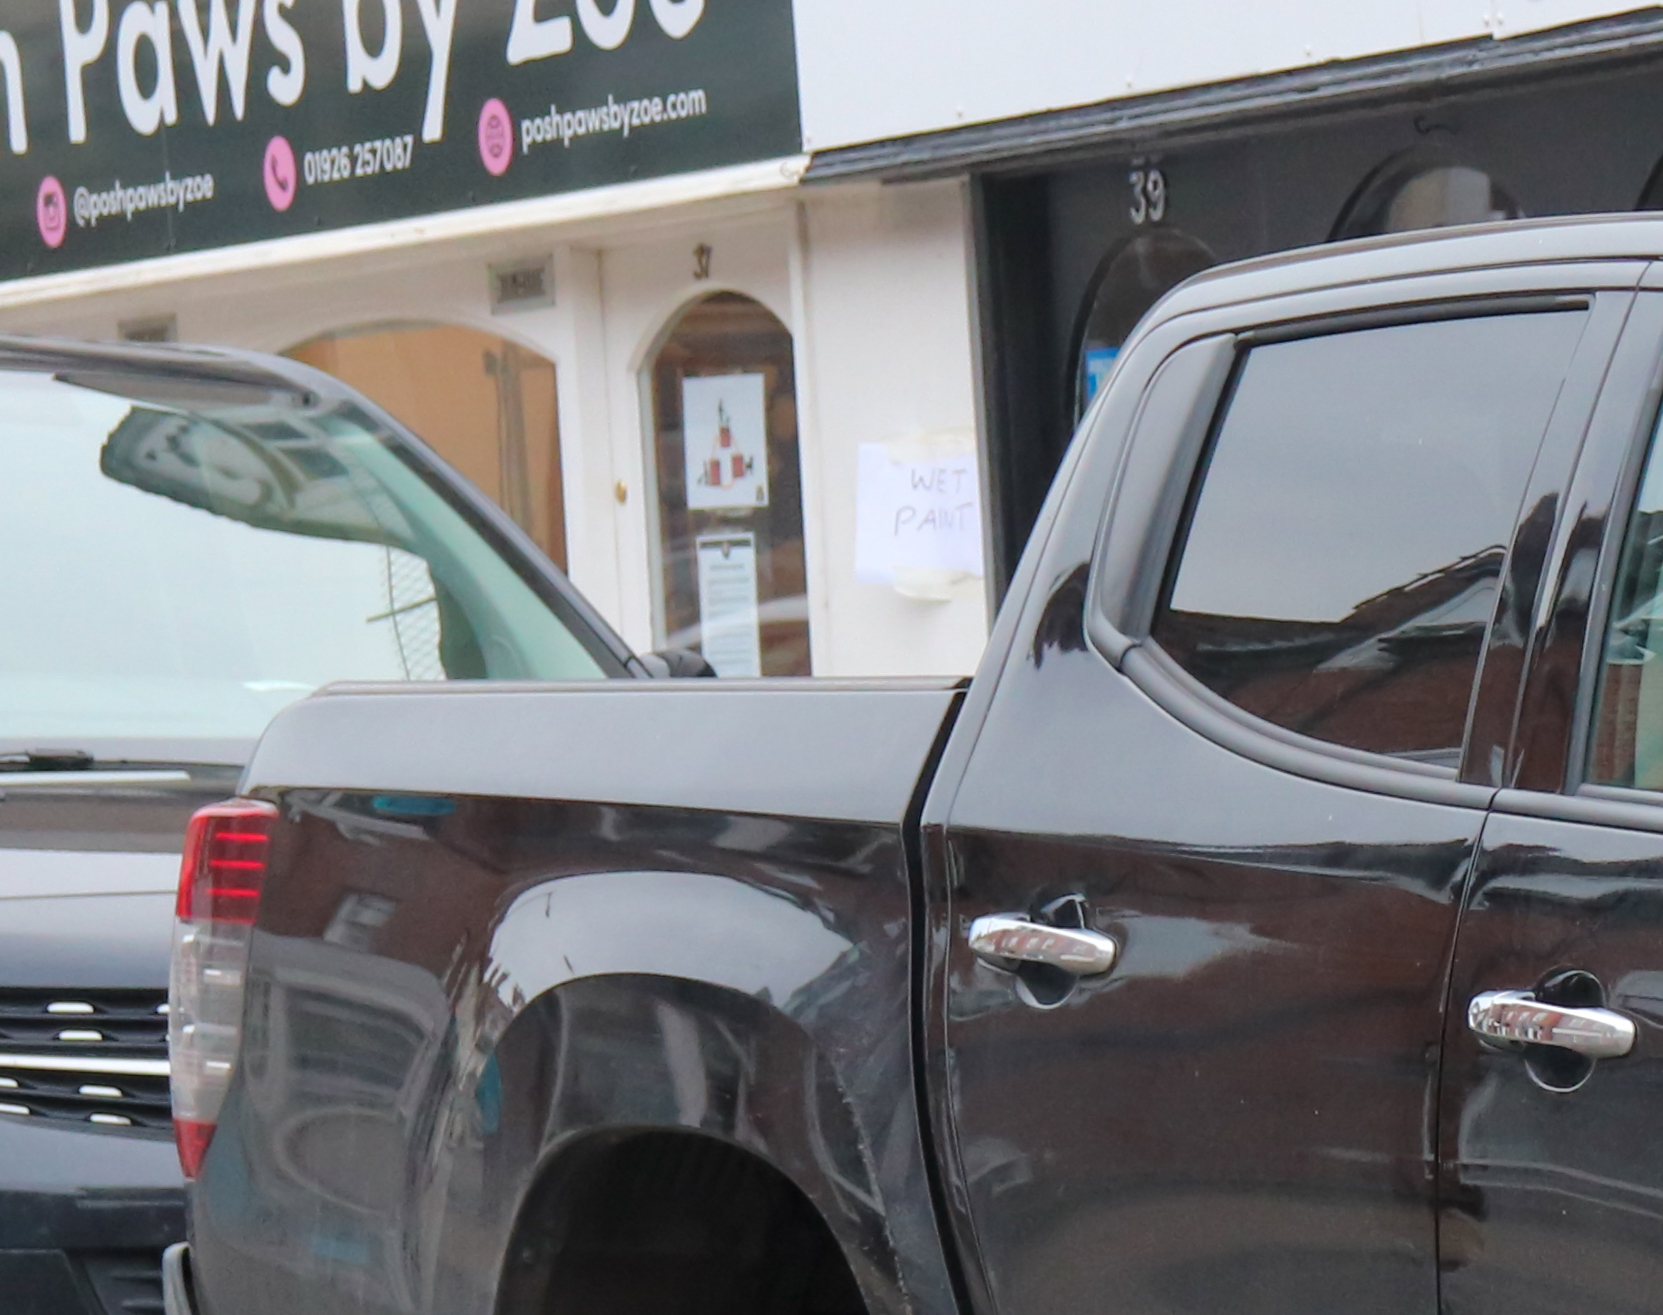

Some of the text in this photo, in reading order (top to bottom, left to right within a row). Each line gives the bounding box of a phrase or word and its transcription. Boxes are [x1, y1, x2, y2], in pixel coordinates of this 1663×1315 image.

[60, 0, 306, 144] Paws
[342, 0, 456, 144] by
[520, 87, 708, 155] poshpawsbyzoe.com
[303, 133, 414, 185] 01926 257087
[73, 170, 214, 228] @poshpawsbyzoe
[1129, 168, 1167, 225] 39
[911, 468, 967, 494] WET
[894, 501, 974, 537] PAINT
